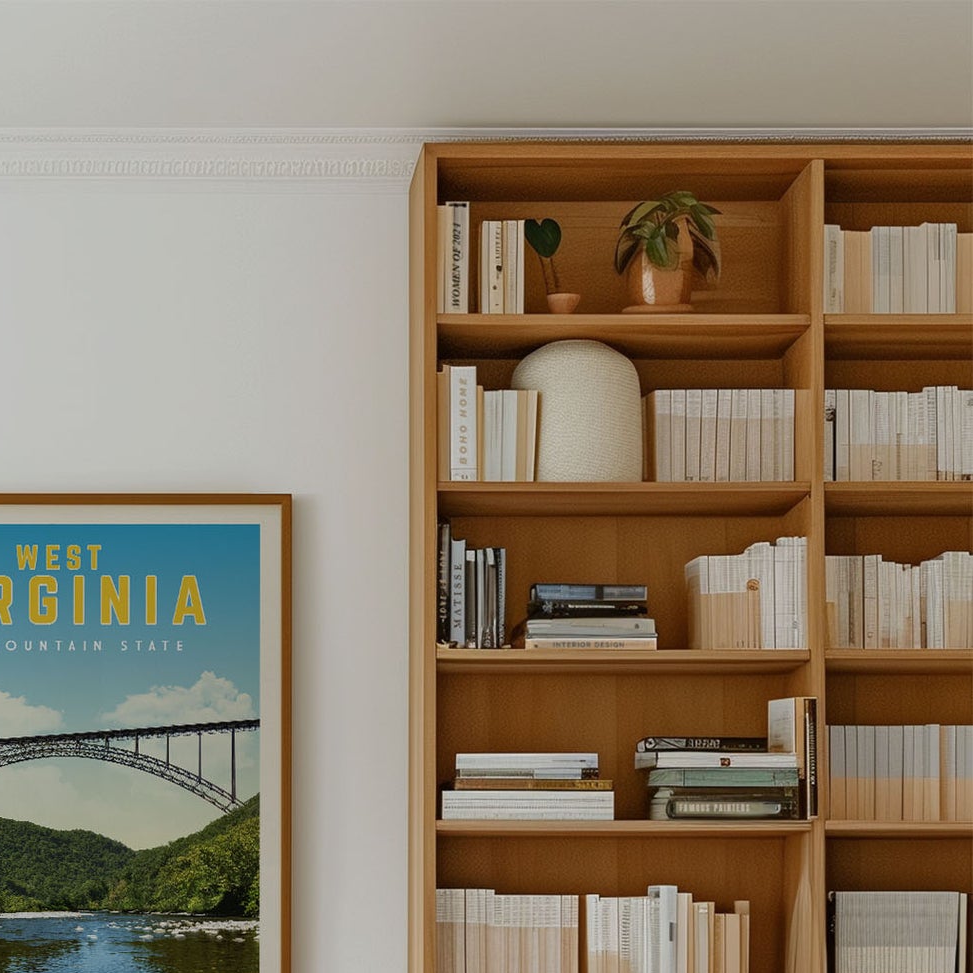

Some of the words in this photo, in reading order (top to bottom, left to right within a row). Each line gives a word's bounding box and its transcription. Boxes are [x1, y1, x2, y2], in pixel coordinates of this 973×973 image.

[451, 247, 461, 261] OF
[451, 264, 460, 307] WOMEN
[459, 377, 467, 418] HOME
[459, 425, 467, 465] BOHO
[15, 544, 102, 571] WEST
[453, 563, 462, 628] MATISSE
[120, 640, 184, 651] STATE
[678, 803, 710, 813] FAMOUS
[712, 803, 750, 813] PAINTERS
